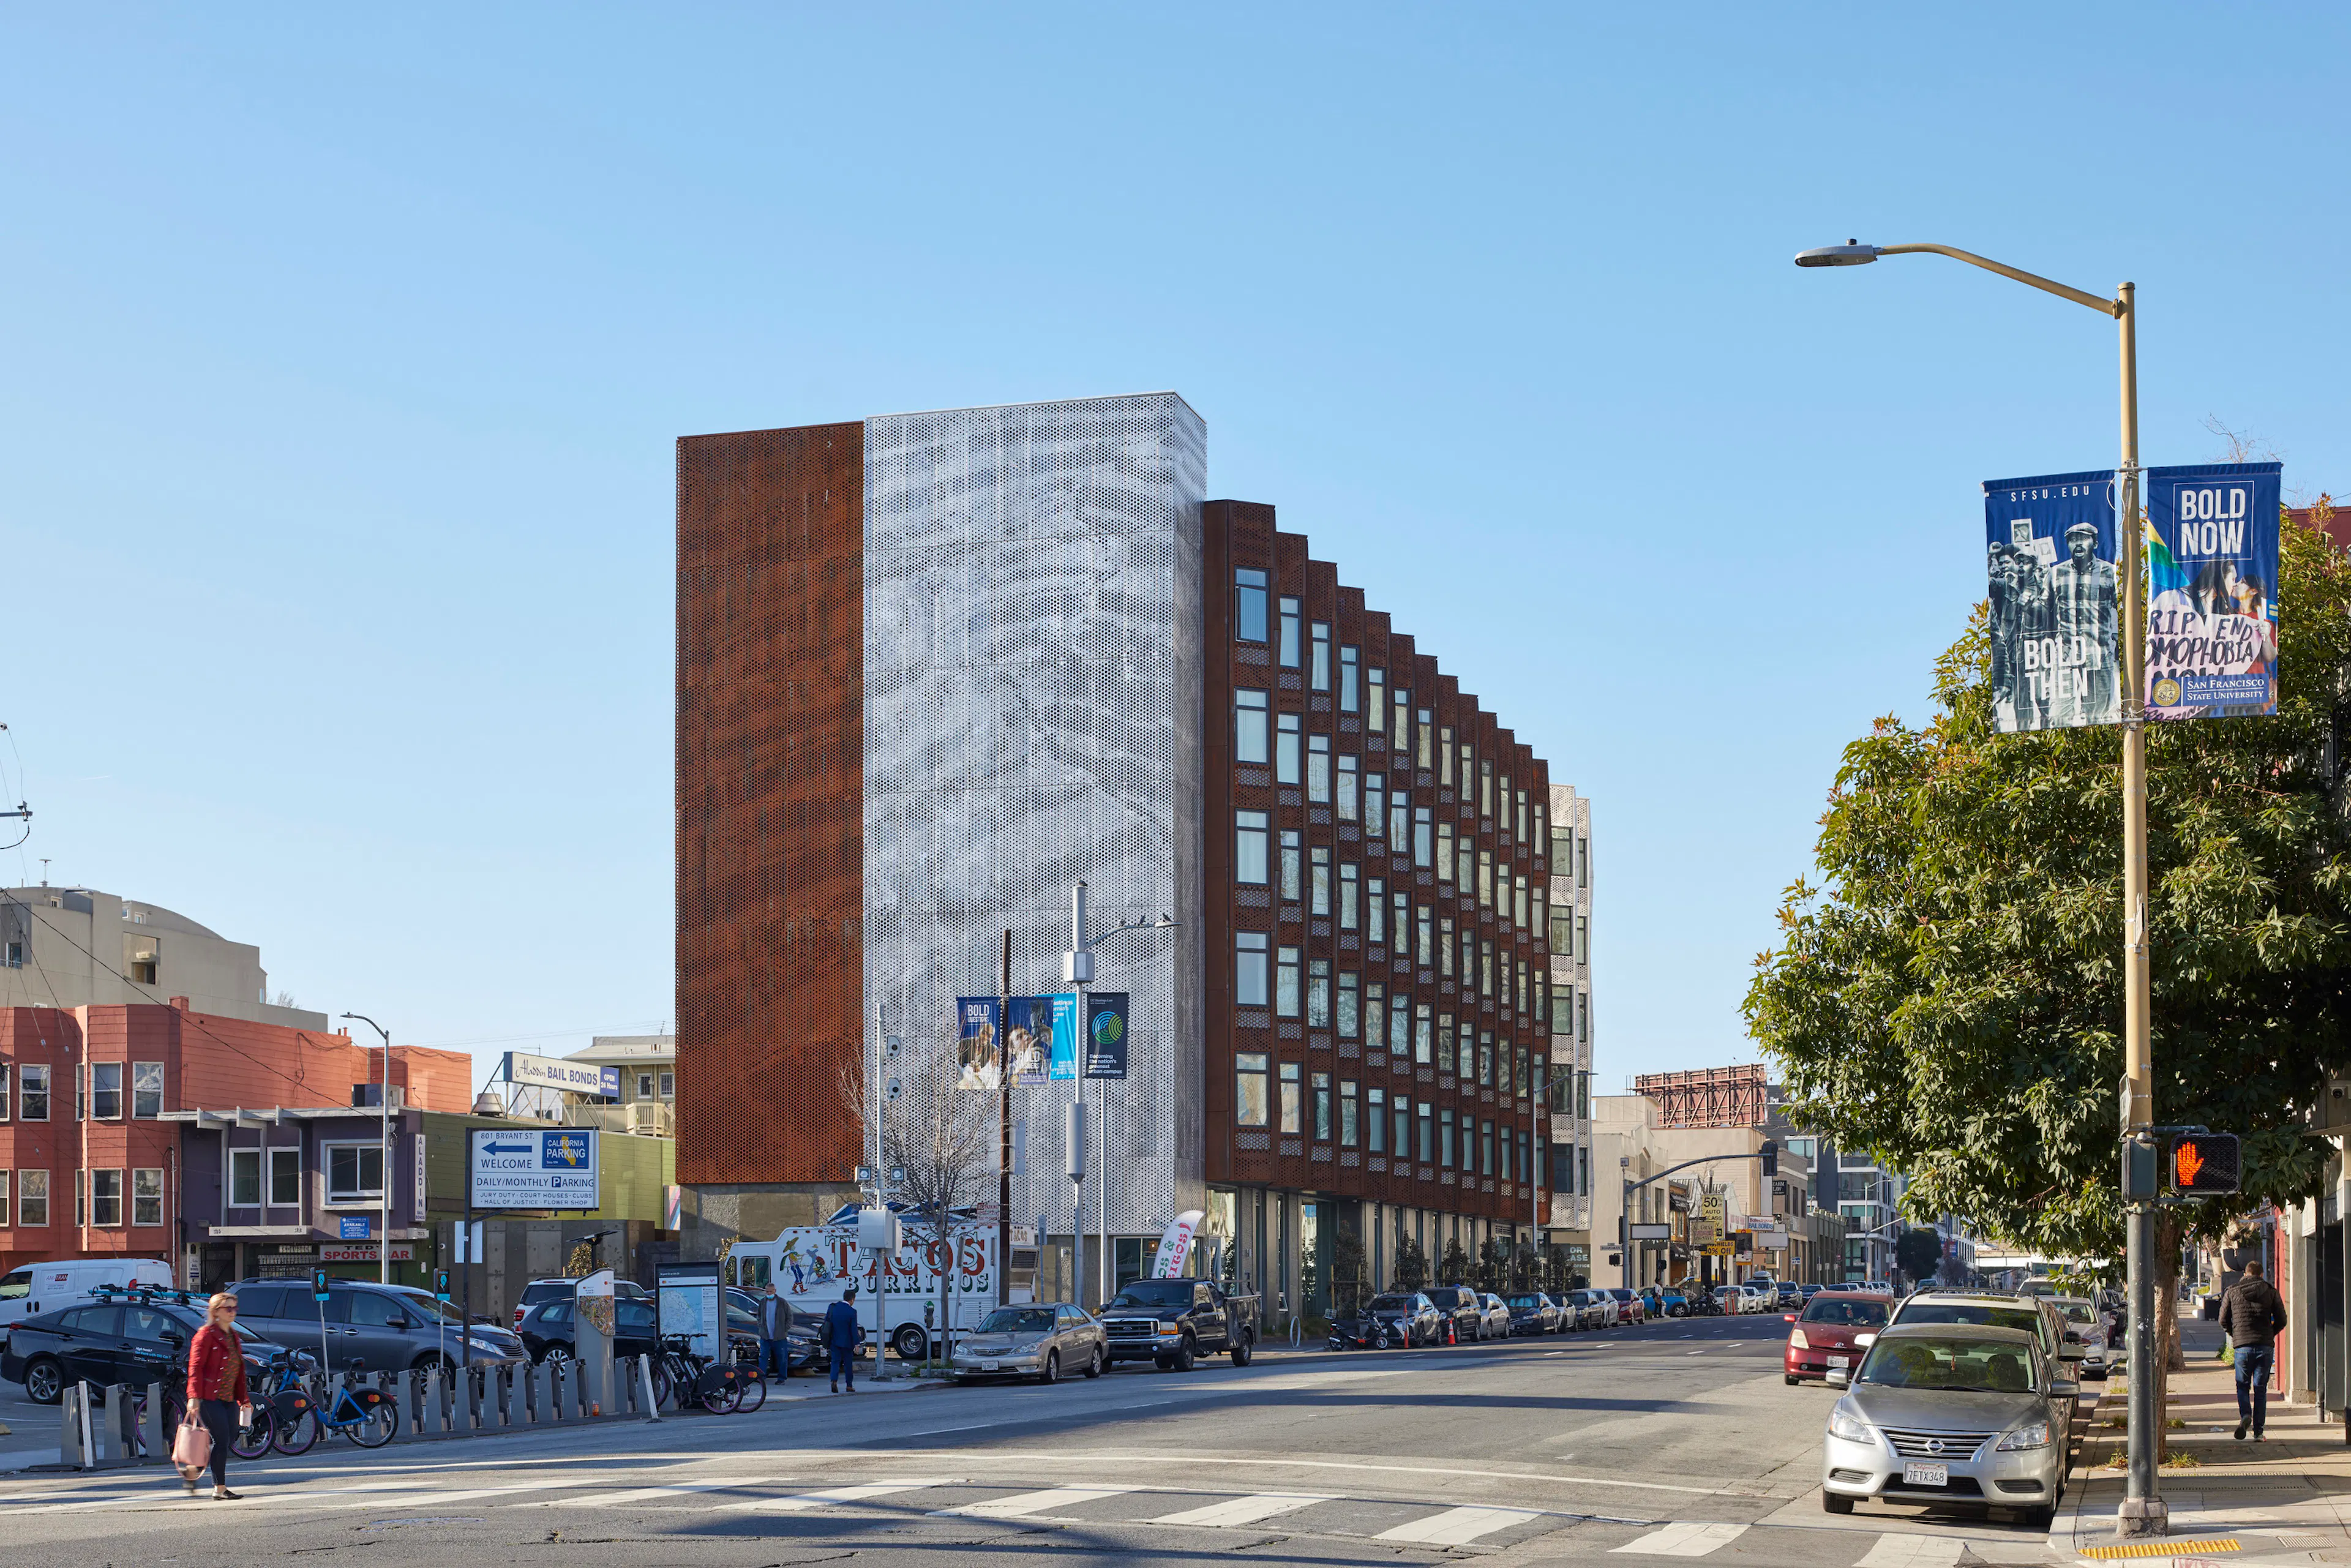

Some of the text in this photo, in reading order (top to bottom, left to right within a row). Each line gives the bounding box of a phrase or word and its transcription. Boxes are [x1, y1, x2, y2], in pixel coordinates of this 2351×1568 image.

[2011, 486, 2089, 502] SFSU.EDU
[2181, 488, 2246, 520] BOLD
[2181, 520, 2244, 557] NOW
[2147, 610, 2195, 635] R.I.P.
[2216, 617, 2252, 642] END
[2024, 636, 2087, 670] BOLD
[2145, 637, 2253, 667] OMOPHOBIA
[2025, 668, 2088, 701] THEN
[967, 1004, 989, 1016] BOLD
[516, 1059, 598, 1086] Aladdin BAIL BONDS
[546, 1149, 585, 1158] PARKING
[481, 1159, 532, 1168] WELCOME
[477, 1177, 594, 1187] DAILY/MONTHLY PARKING
[1704, 1197, 1717, 1207] 50
[1010, 1229, 1027, 1242] TACOS
[324, 1250, 410, 1259] SPORTS AR
[1908, 1470, 1944, 1482] 7FTX348
